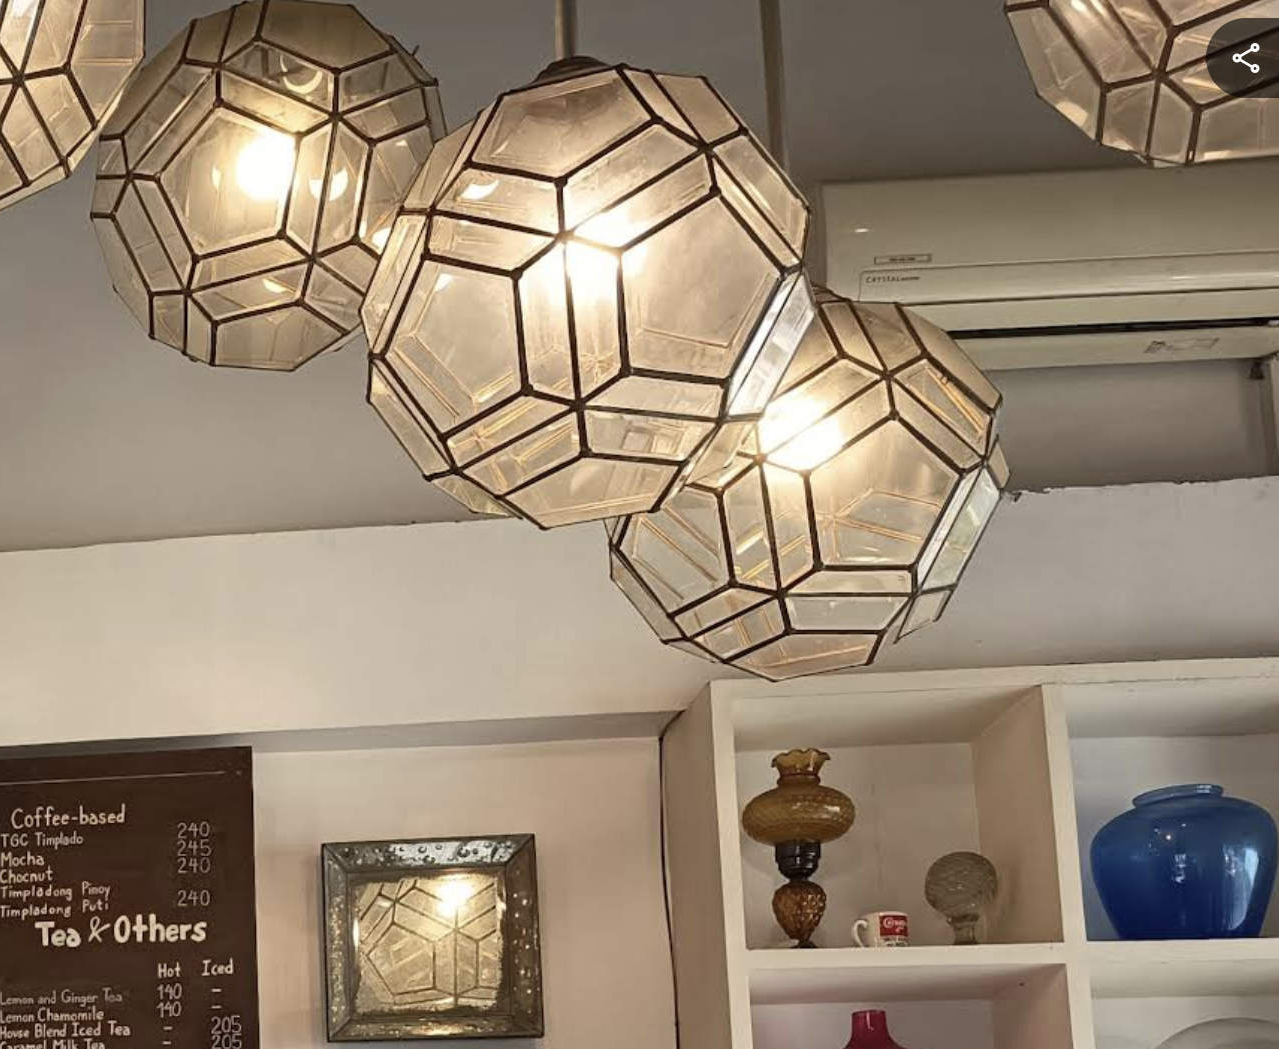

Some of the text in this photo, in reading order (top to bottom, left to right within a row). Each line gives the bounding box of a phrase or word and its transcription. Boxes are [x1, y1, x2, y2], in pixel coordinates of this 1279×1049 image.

[11, 803, 125, 829] Coffee-based
[1, 831, 83, 850] TGC Timplado
[1, 852, 45, 867] Mocha
[0, 867, 53, 885] Chocnut
[0, 881, 111, 902] Timpladong Pinoy
[0, 899, 109, 920] Timpladong Puti
[35, 914, 207, 947] Tea & Others
[158, 958, 234, 978] Hot Iced
[0, 987, 123, 1007] Lemon and Ginger Tea
[0, 1006, 104, 1023] Lemon Chamomile
[0, 1020, 131, 1040] House Blend Iced Tea
